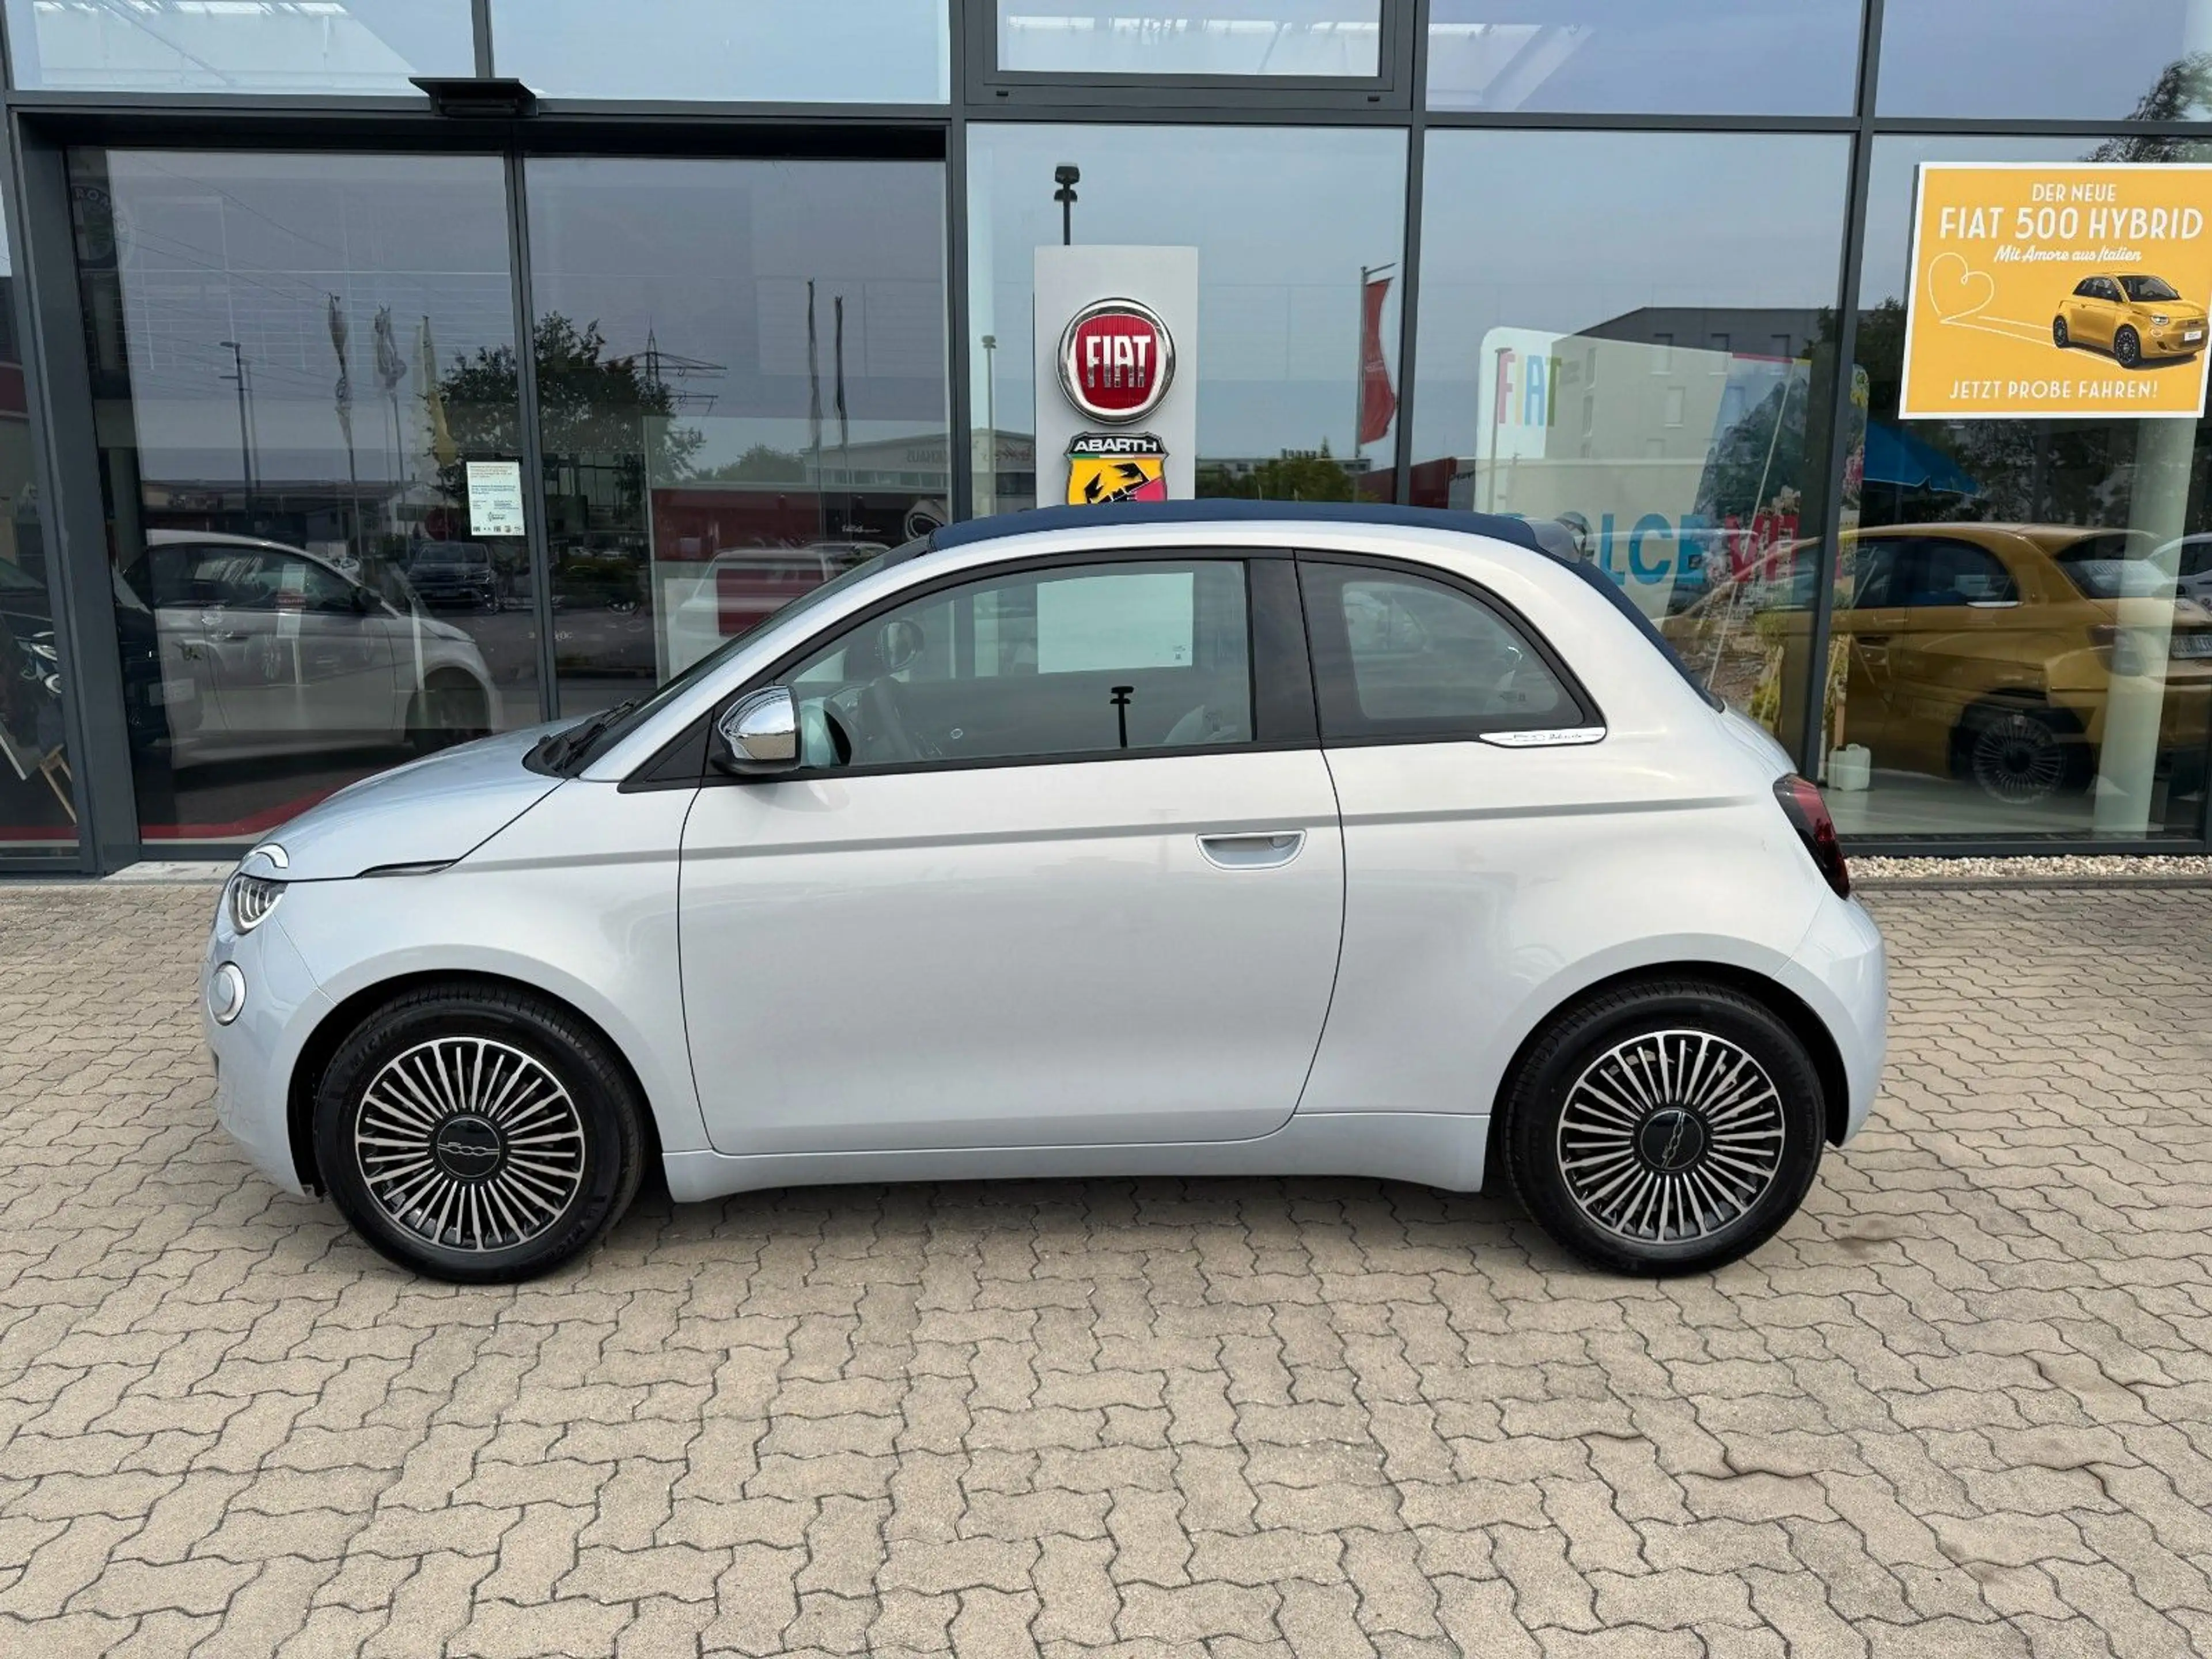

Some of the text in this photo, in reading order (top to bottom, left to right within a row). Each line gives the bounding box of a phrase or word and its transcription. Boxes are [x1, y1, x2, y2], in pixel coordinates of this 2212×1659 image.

[2032, 183, 2118, 202] DER NEUE
[1939, 206, 2204, 240] FIAT 500 HYBRID
[2072, 249, 2097, 262] aus
[2097, 244, 2142, 263] Italien
[1085, 335, 1152, 388] FIAT
[1498, 351, 1562, 428] FIAT
[1949, 380, 2158, 399] JETZT PROBE FAHREN!
[1073, 438, 1158, 452] ABARTH
